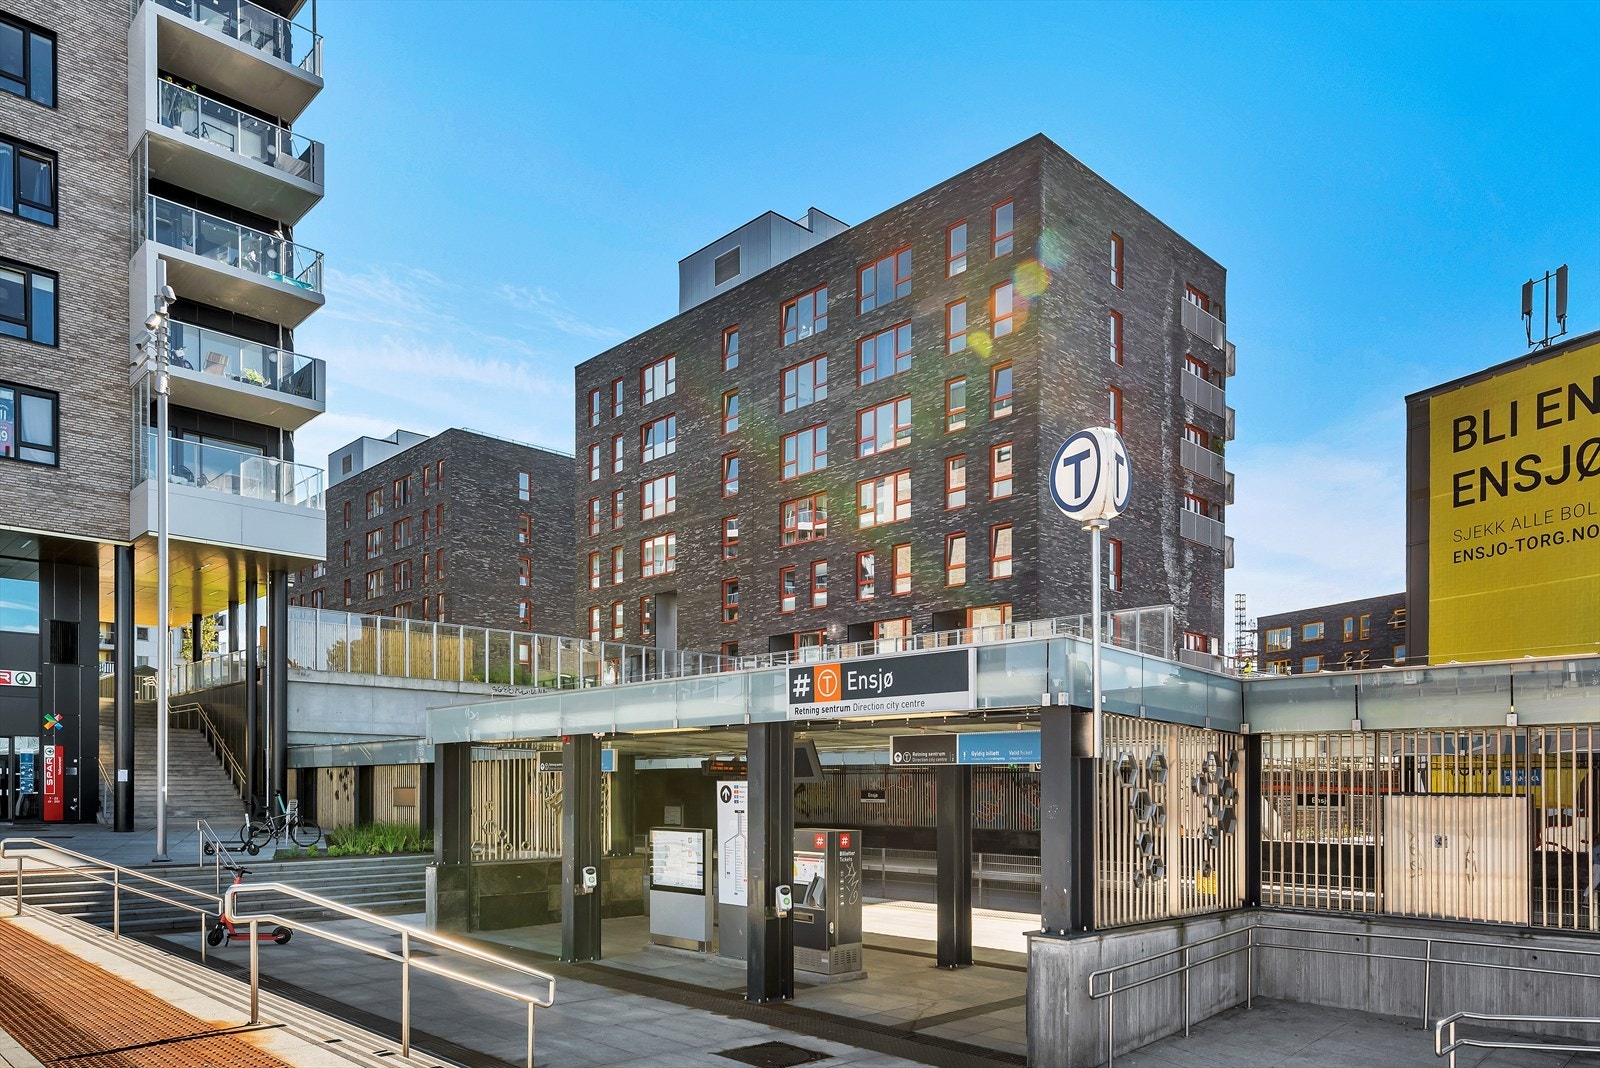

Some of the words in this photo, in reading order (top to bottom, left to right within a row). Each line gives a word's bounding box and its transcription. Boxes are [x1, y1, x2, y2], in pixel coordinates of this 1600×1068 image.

[1453, 400, 1518, 453] BLI
[1536, 375, 1600, 430] EN
[1453, 437, 1600, 508] ENSJØ
[1453, 519, 1506, 543] SJEKK
[1510, 509, 1554, 531] ALLE
[1560, 501, 1597, 521] BOL
[1453, 524, 1600, 564] ENSJO-TORG.NO
[847, 668, 894, 694] Ensjø
[794, 706, 820, 716] Retning
[821, 704, 851, 714] sentrum
[852, 702, 885, 712] Direction
[886, 700, 900, 711] city
[901, 699, 926, 709] centre
[46, 757, 54, 786] SPAR
